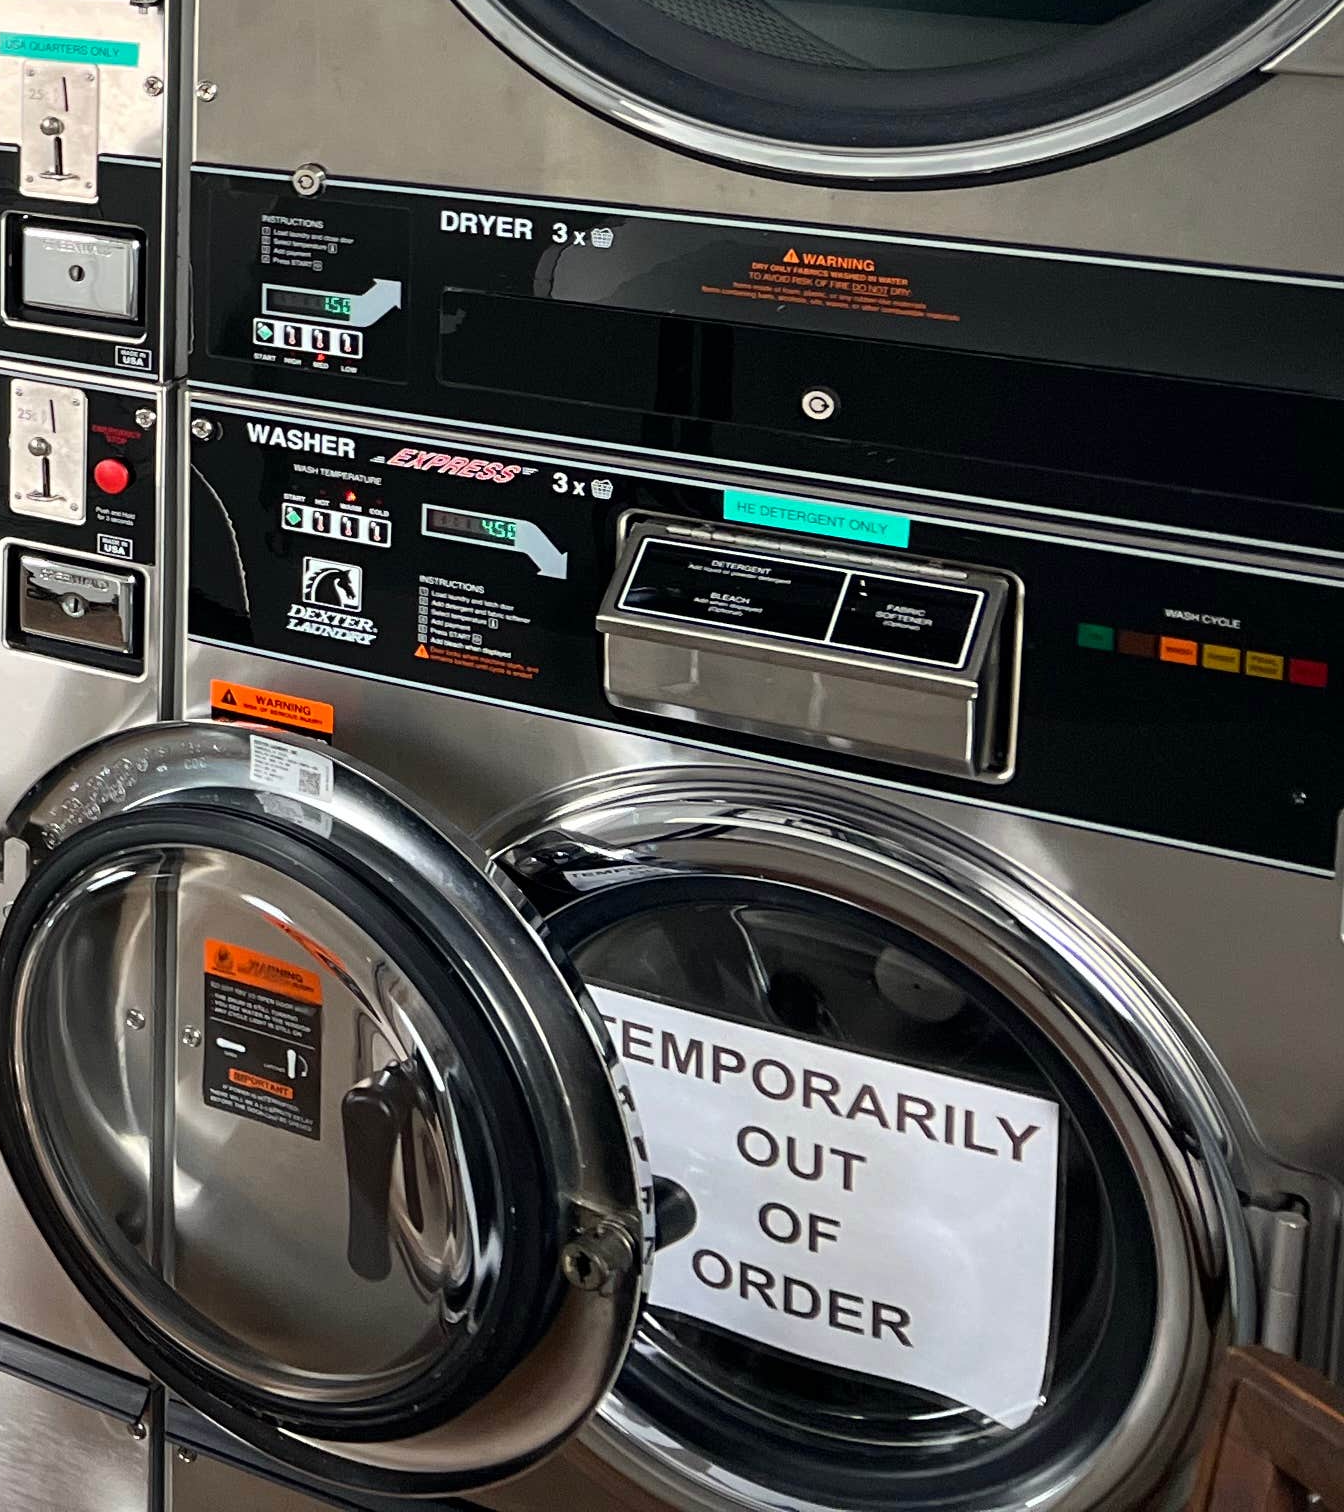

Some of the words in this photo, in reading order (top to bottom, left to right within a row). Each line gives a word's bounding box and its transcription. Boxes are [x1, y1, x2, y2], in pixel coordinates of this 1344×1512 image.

[5, 39, 25, 51] USA
[29, 41, 88, 56] QUARTERS
[91, 45, 120, 58] ONLY
[262, 214, 324, 229] INSTRUCTIONS
[441, 210, 533, 239] DRYER
[552, 223, 568, 244] 3
[573, 231, 586, 246] x
[802, 253, 875, 271] WARNING
[122, 356, 144, 366] USA
[247, 422, 356, 459] WASHER
[387, 448, 522, 484] EXPRESS
[552, 473, 568, 493] 3
[572, 480, 585, 496] x
[293, 463, 318, 475] WASH
[320, 467, 382, 486] TEMPERATURE
[737, 501, 756, 514] HE
[760, 505, 845, 529] DETERGENT
[849, 519, 889, 535] ONLY
[104, 542, 125, 555] USA
[712, 560, 772, 575] DETERGENT
[419, 575, 485, 594] INSTRUCTIONS
[710, 592, 750, 604] BLEACH
[287, 603, 375, 632] DEXTER
[1165, 608, 1199, 622] WASH
[1201, 613, 1241, 629] CYCLE
[286, 618, 377, 646] LAUNDRY
[256, 695, 311, 716] WARNING
[601, 1014, 1041, 1162] EMPORARILY
[736, 1126, 867, 1192] OUT
[758, 1203, 840, 1253] OF
[692, 1249, 915, 1349] ORDER
